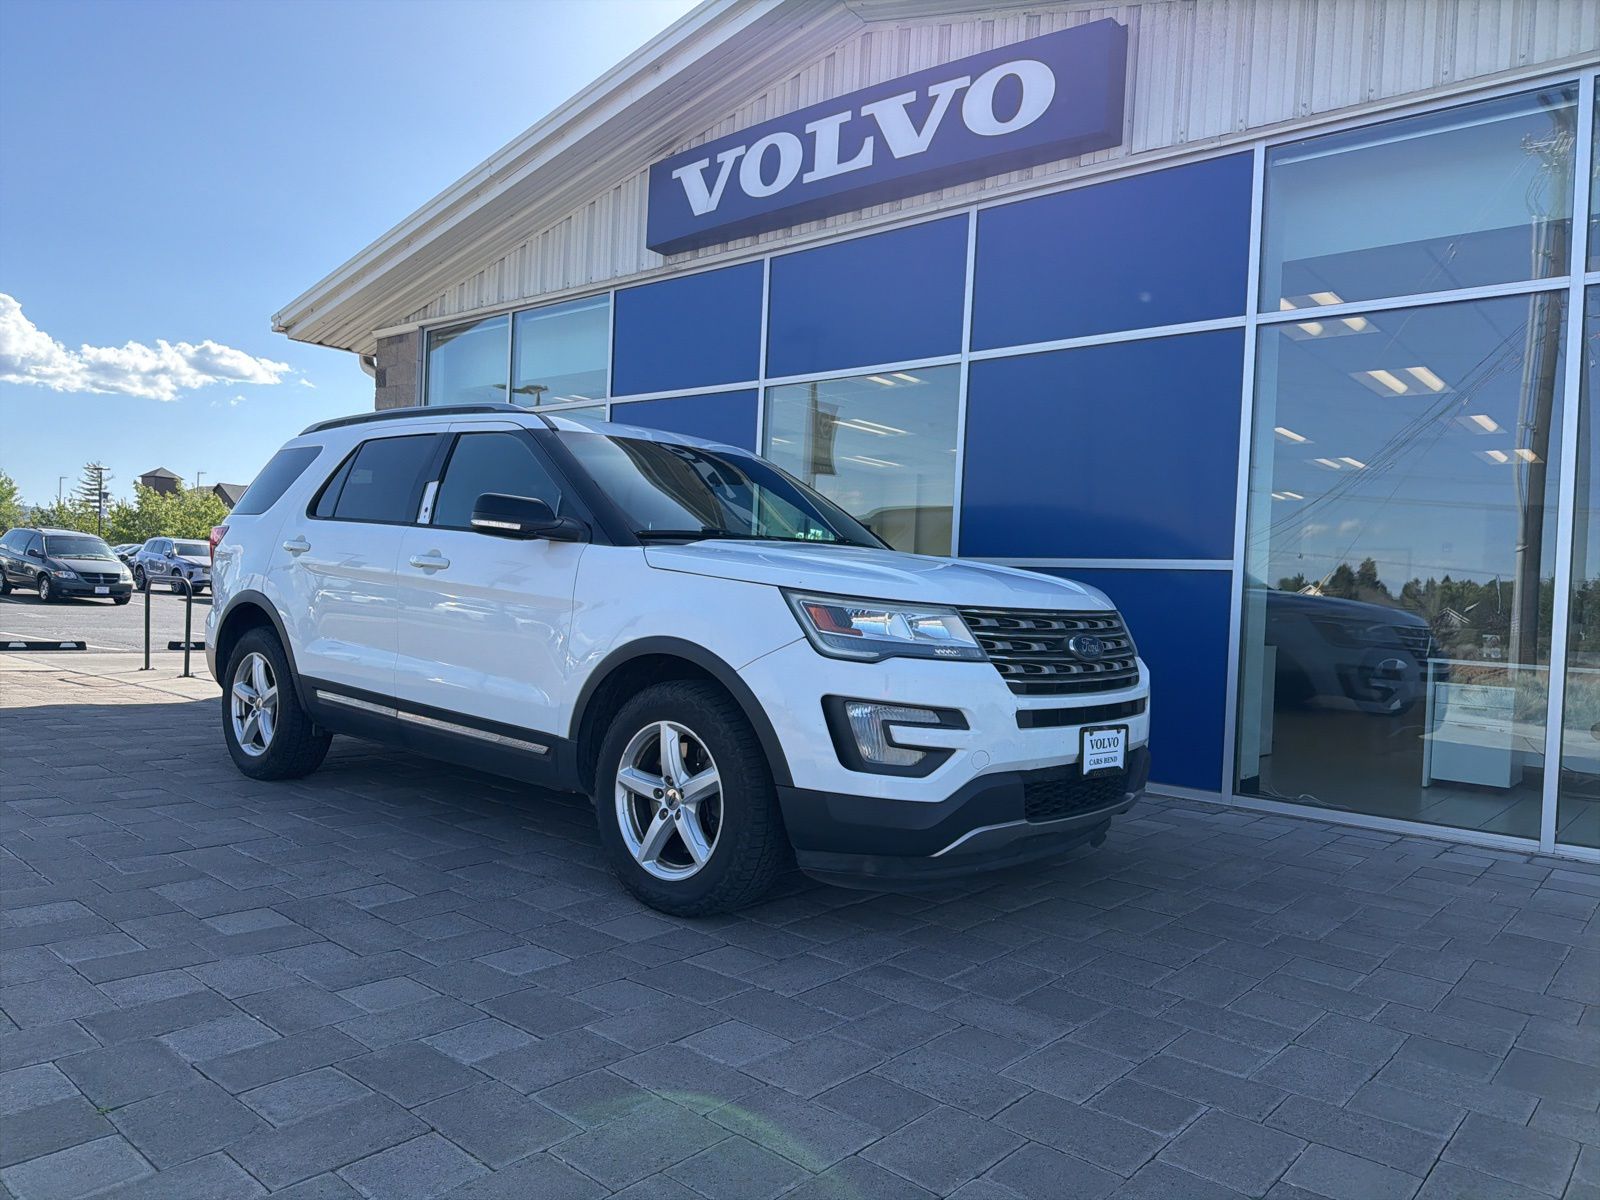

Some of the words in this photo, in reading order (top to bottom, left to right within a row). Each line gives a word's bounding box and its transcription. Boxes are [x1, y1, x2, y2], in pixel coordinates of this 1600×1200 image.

[672, 59, 1056, 217] VOLVO
[1081, 637, 1100, 652] Ford
[1089, 737, 1119, 750] VOLVO
[1089, 757, 1103, 766] CARS
[1104, 756, 1118, 764] BEND
